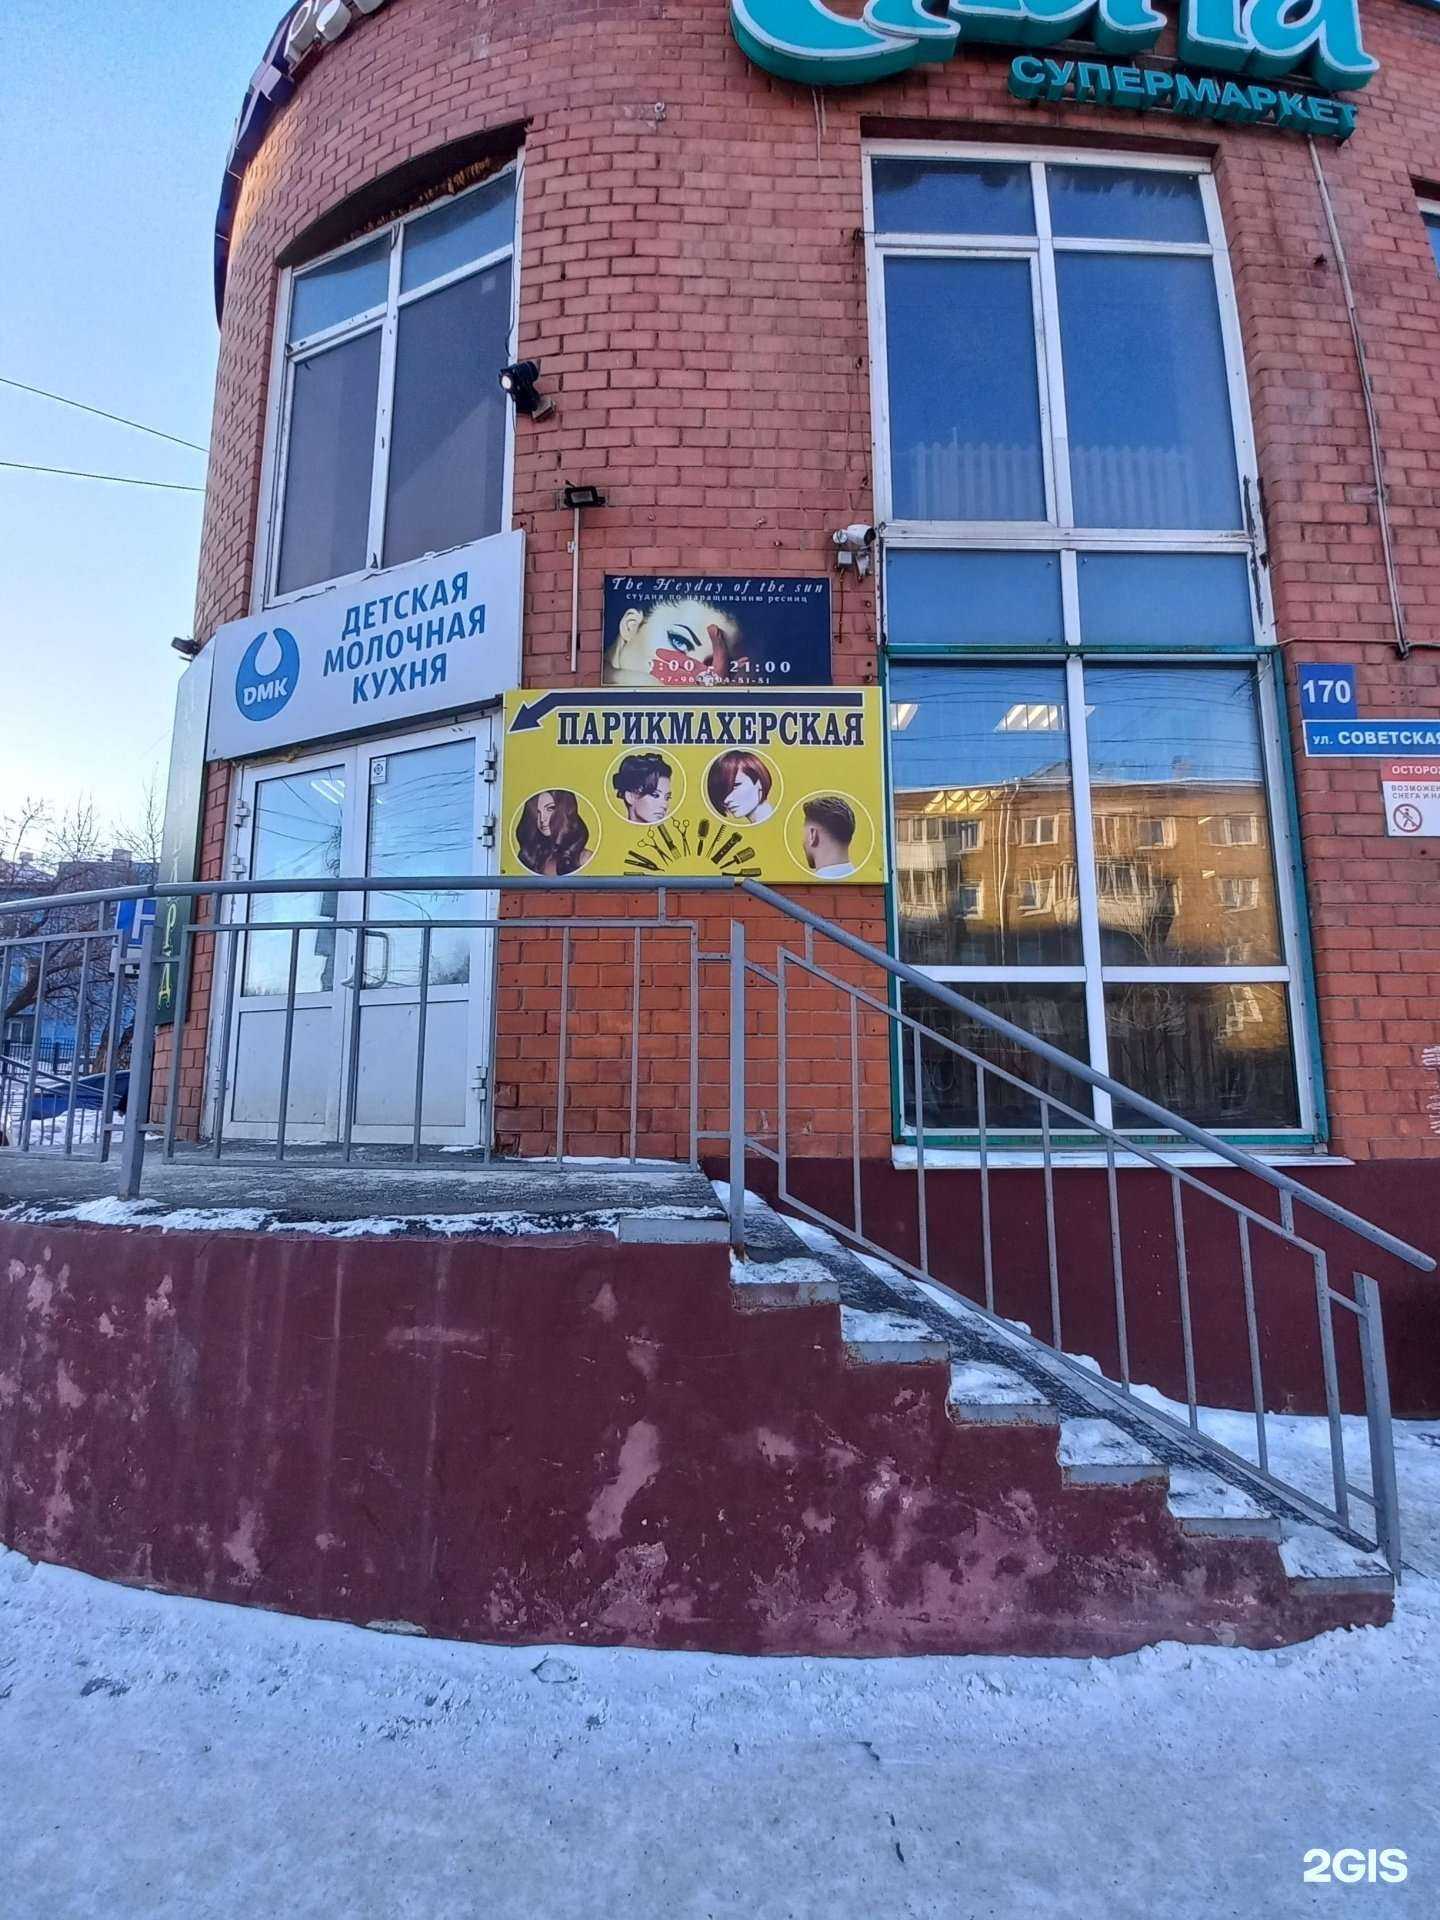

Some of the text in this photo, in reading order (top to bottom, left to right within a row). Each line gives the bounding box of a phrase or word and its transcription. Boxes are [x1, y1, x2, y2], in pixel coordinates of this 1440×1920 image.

[1009, 54, 1358, 132] СУПЕРМАРКЕТ
[652, 578, 723, 594] Heyday
[733, 579, 752, 595] of
[759, 580, 785, 593] the
[794, 583, 823, 593] sun
[341, 571, 469, 641] ДЕТСКАЯ
[322, 604, 486, 677] МОЛОЧНАЯ
[351, 653, 448, 704] КУХНЯ
[729, 660, 792, 674] 21:00
[1302, 680, 1351, 704] 170
[556, 711, 864, 745] DMK
[1313, 735, 1334, 745] ул.
[1391, 765, 1440, 775] ОСТОРО
